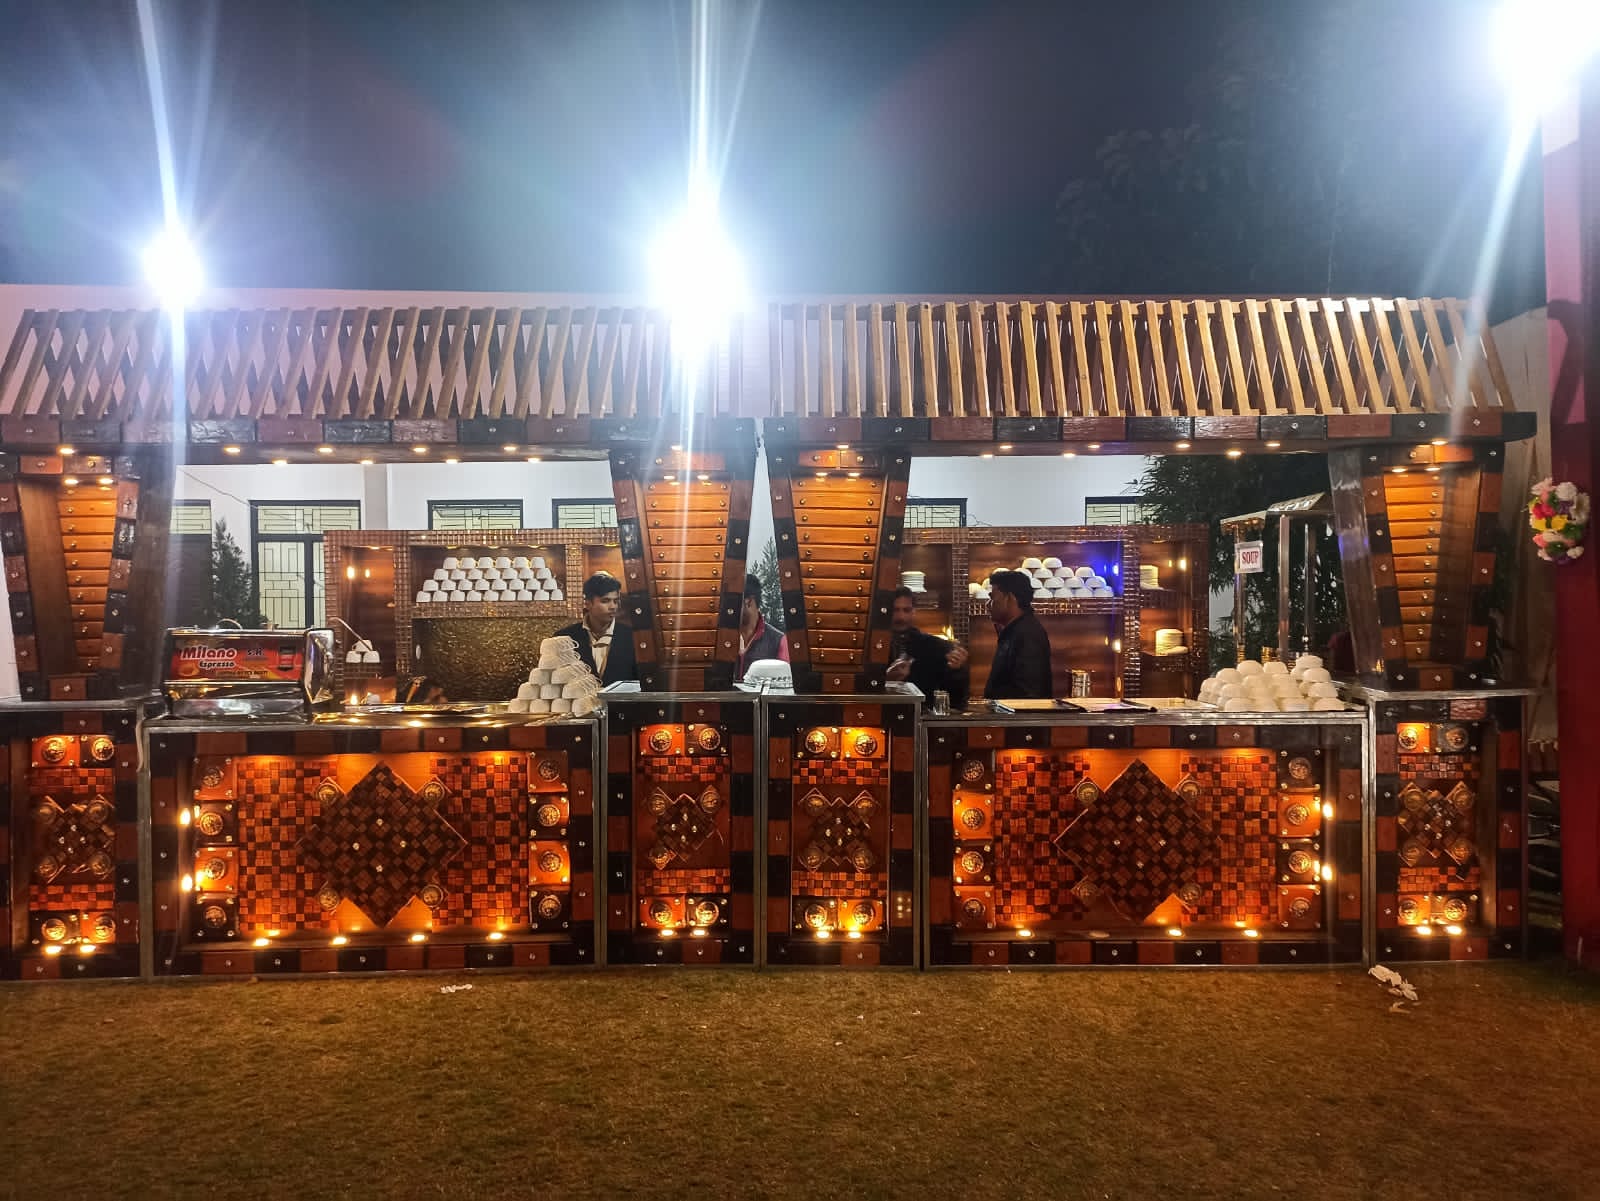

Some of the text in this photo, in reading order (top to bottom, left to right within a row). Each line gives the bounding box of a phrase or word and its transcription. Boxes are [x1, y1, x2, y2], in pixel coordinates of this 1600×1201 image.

[1242, 551, 1258, 564] SOUP
[182, 646, 236, 659] Milano
[199, 660, 235, 669] Espresso
